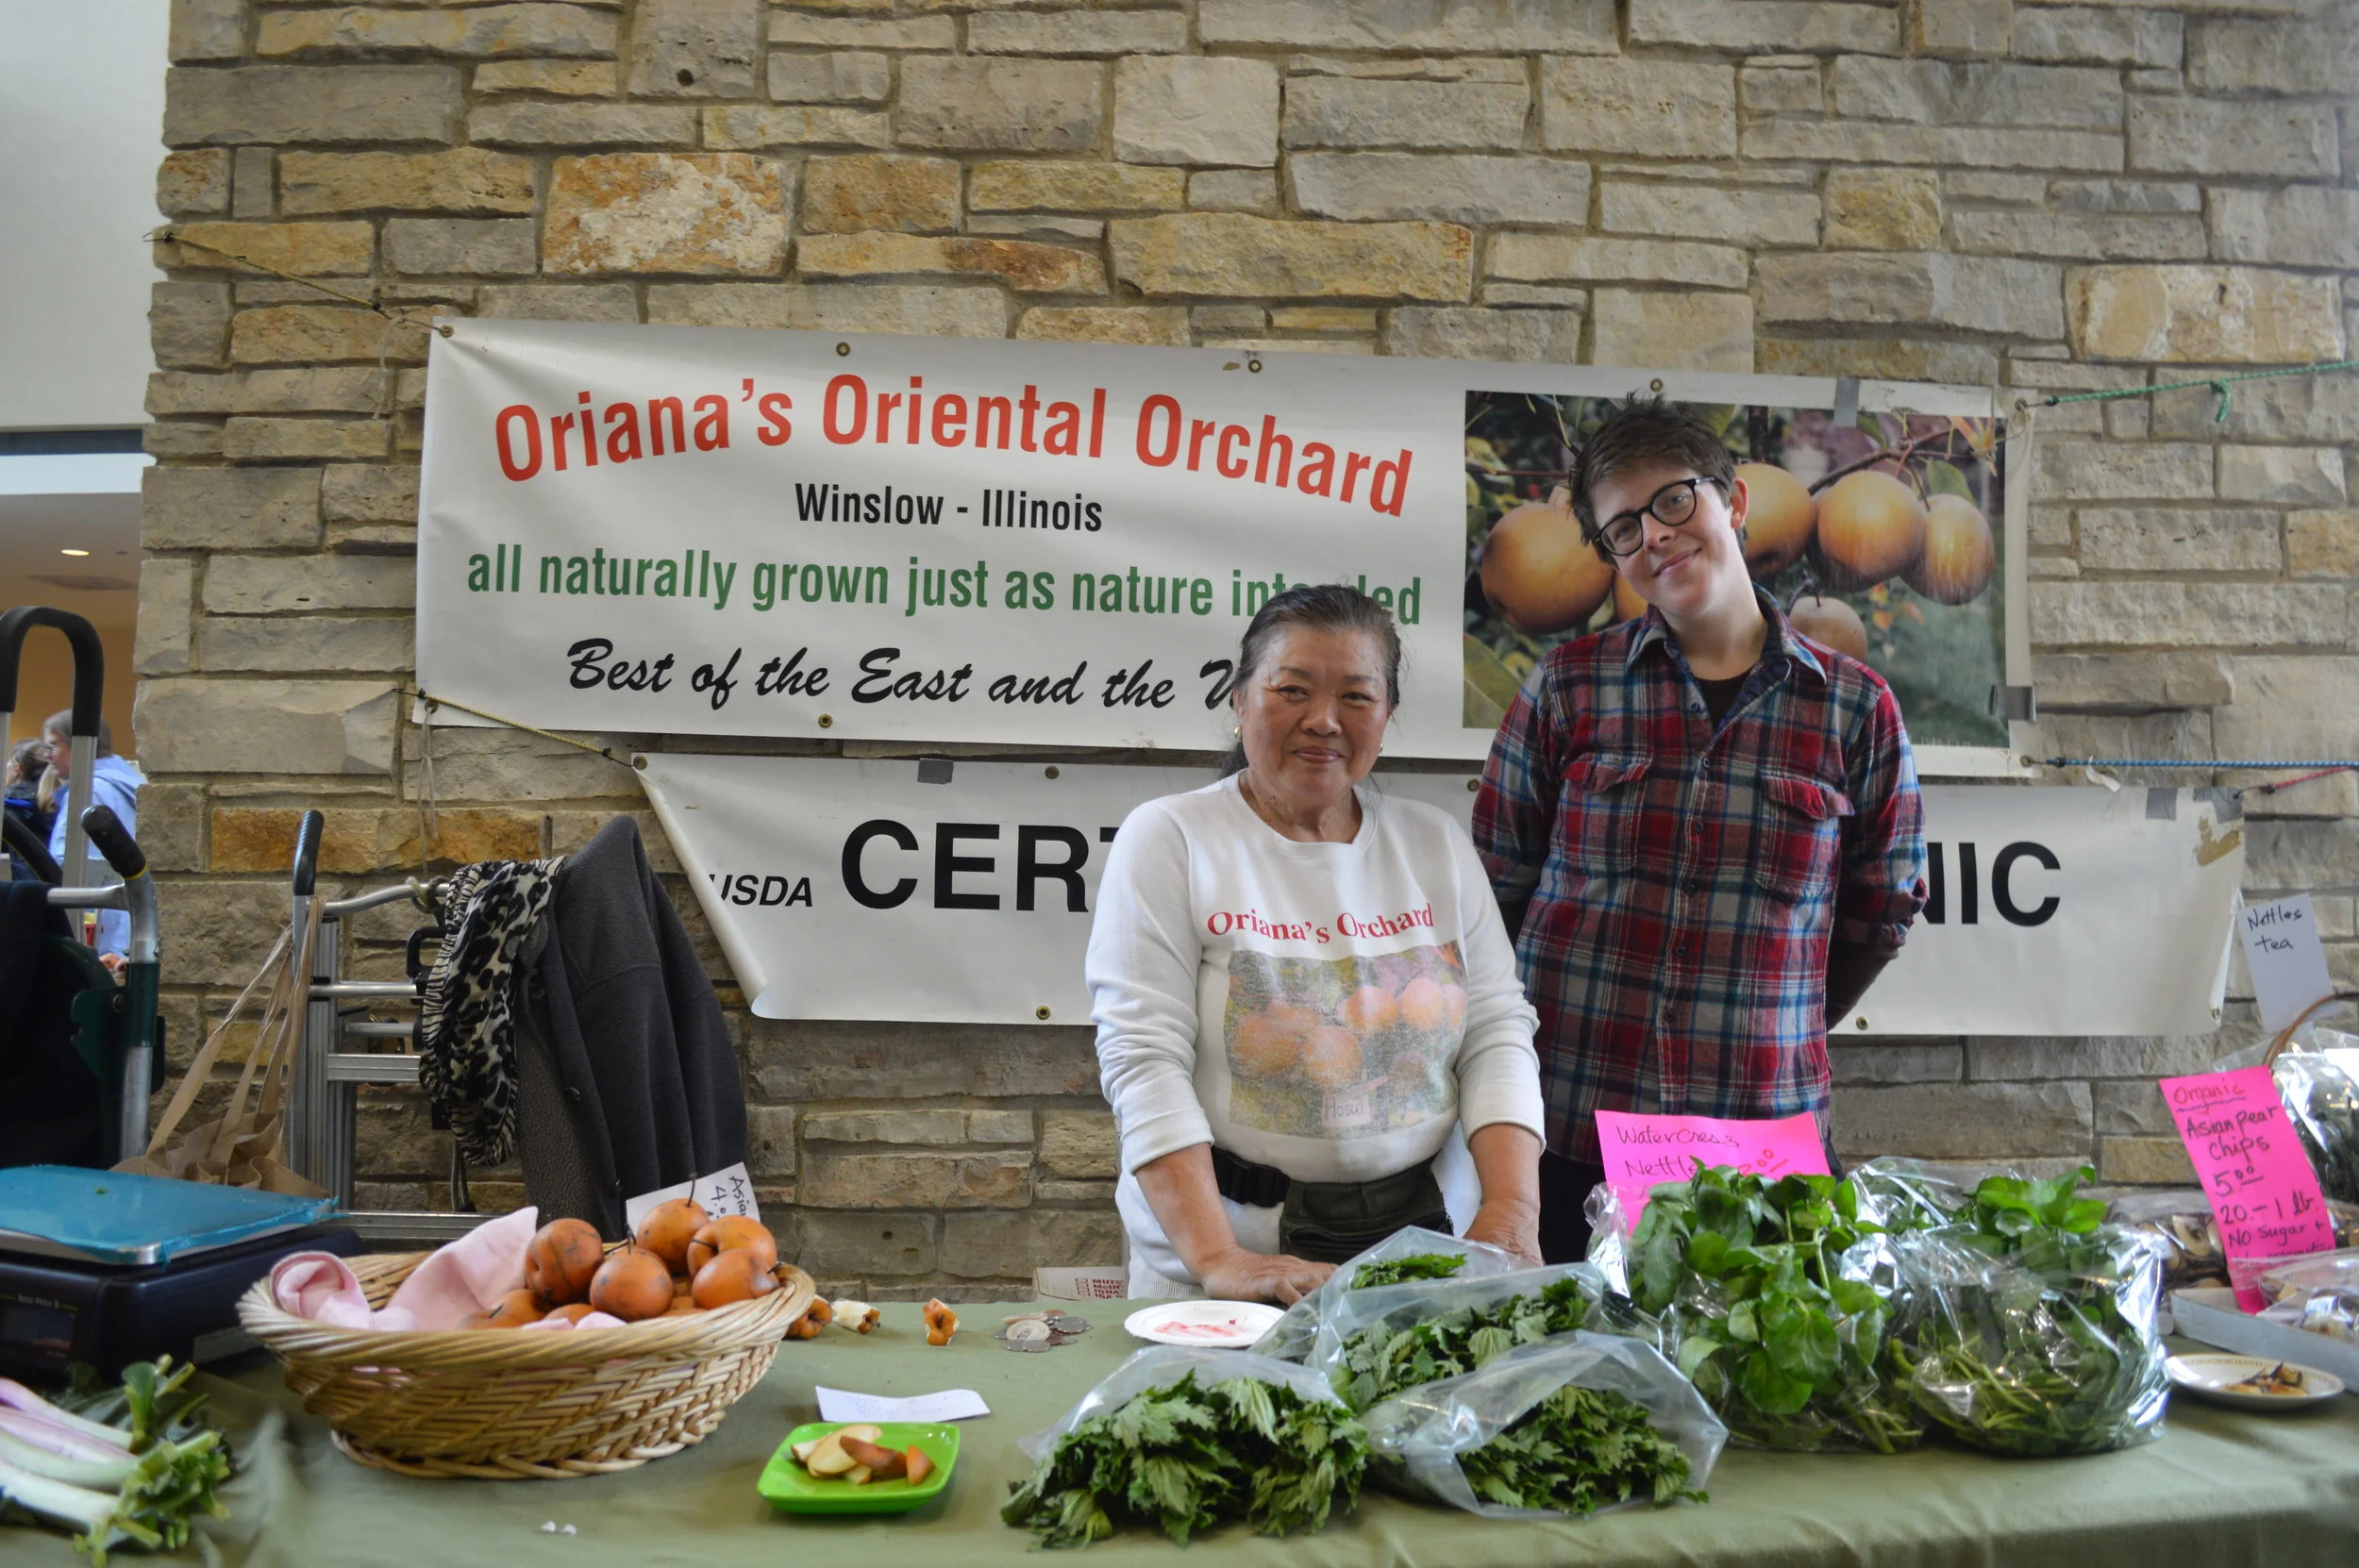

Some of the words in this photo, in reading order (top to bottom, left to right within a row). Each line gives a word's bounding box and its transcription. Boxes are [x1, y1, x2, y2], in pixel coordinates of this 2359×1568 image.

[495, 378, 793, 482] Oriana's
[823, 374, 1107, 459] Oriental
[1135, 393, 1413, 518] Orchard
[795, 483, 945, 525] Winslow
[982, 489, 1102, 532] Illinois
[468, 543, 522, 593] all
[539, 547, 737, 610] naturally
[752, 562, 889, 612] grown
[905, 557, 988, 617] just
[1004, 568, 1055, 610] as
[1072, 566, 1213, 616] nature
[566, 637, 677, 693] Best
[691, 646, 744, 711] of
[754, 645, 831, 697] the
[851, 647, 973, 704] East
[988, 660, 1088, 706] and
[1101, 659, 1176, 709] the
[1207, 909, 1330, 944] Oriana's
[1336, 903, 1435, 939] Orchard
[2247, 904, 2303, 931] Nettles
[2253, 935, 2294, 954] tea
[2173, 1077, 2246, 1108] Organic
